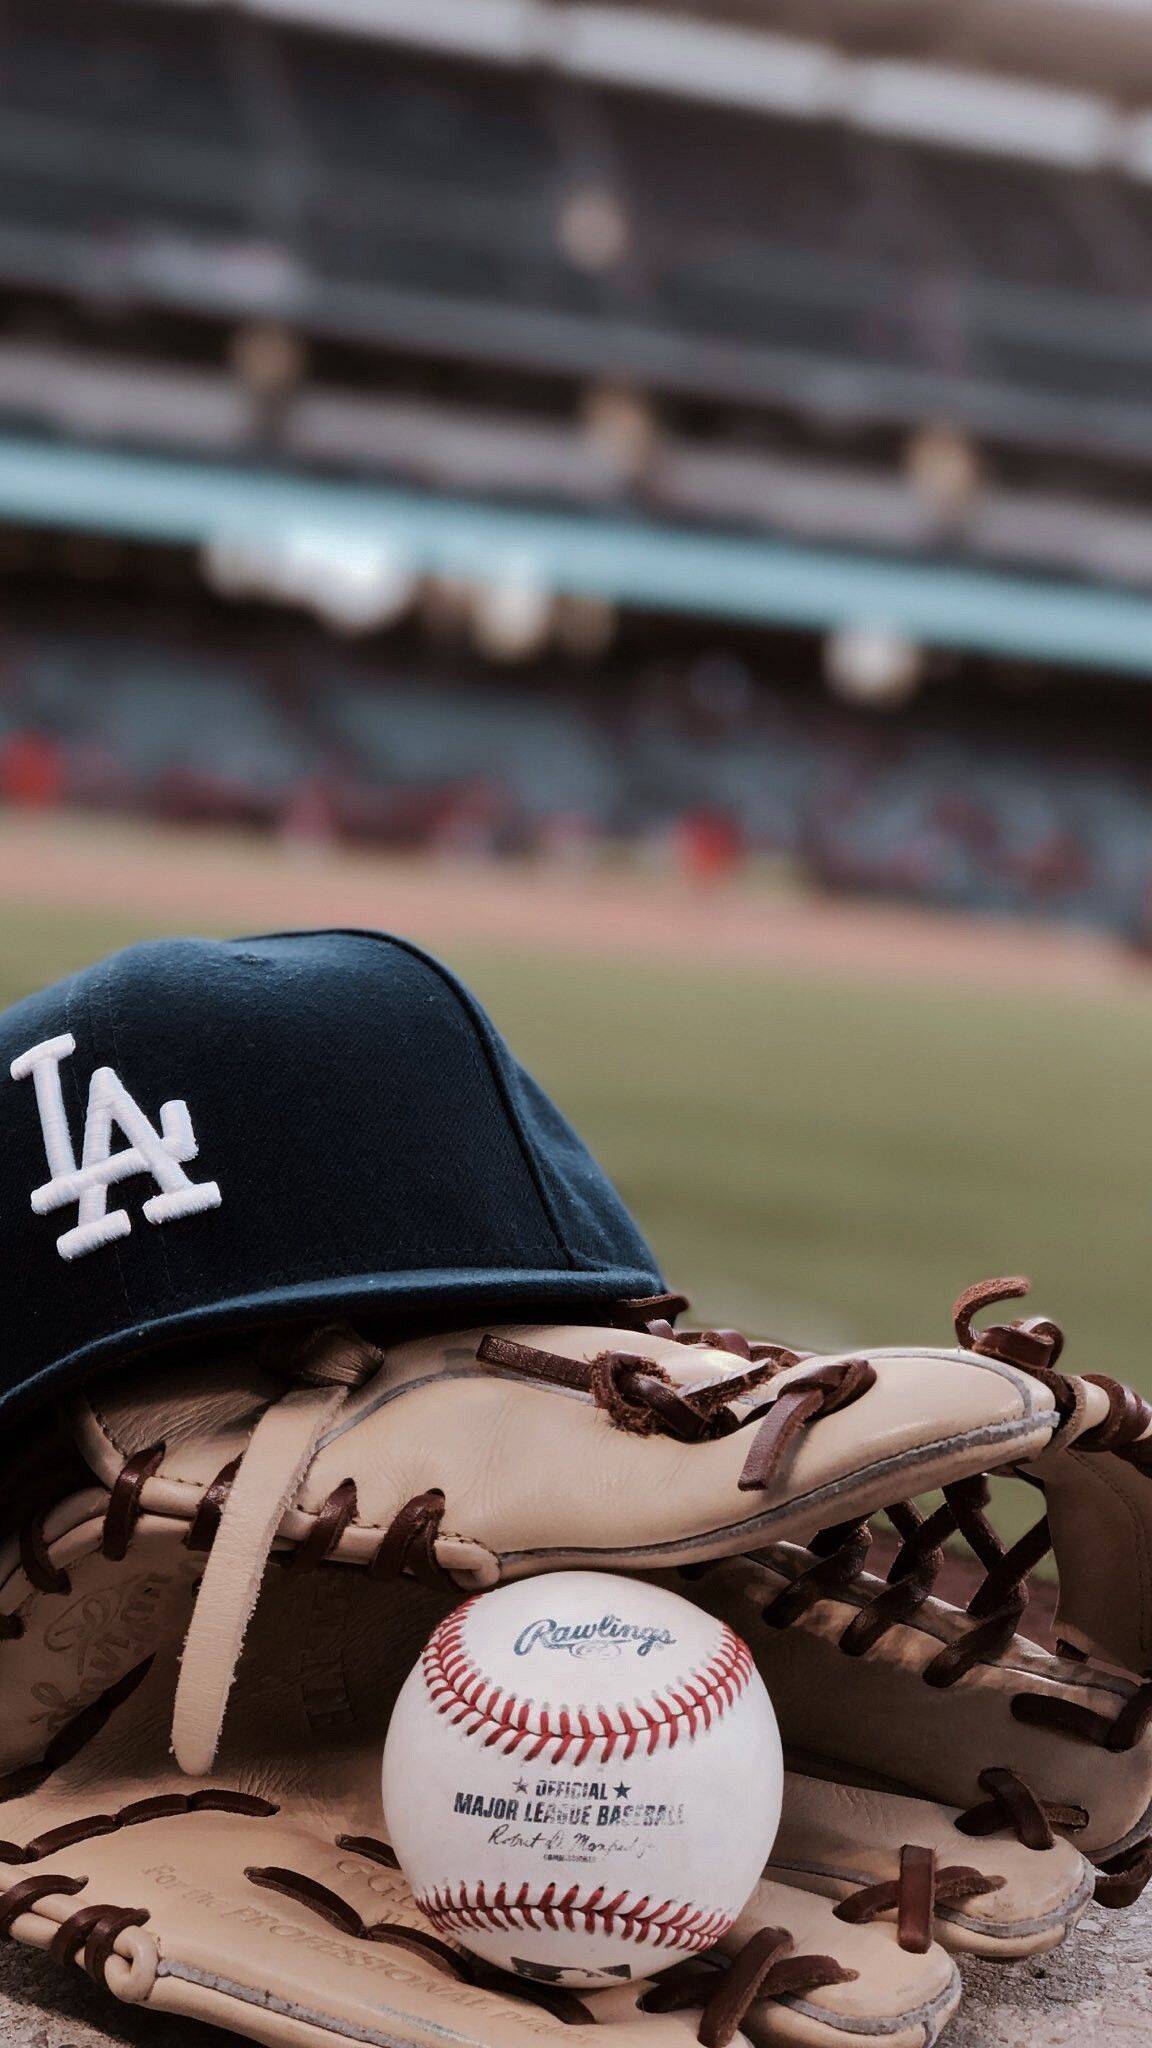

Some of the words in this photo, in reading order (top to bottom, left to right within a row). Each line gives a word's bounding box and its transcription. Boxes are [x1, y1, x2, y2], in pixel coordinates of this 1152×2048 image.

[10, 1033, 222, 1261] LA
[514, 1614, 677, 1656] Rawlings
[536, 1780, 608, 1800] OFFICIAL
[453, 1792, 519, 1821] MAJOR
[523, 1801, 592, 1826] LEAGUE
[596, 1804, 686, 1827] BASEBALL
